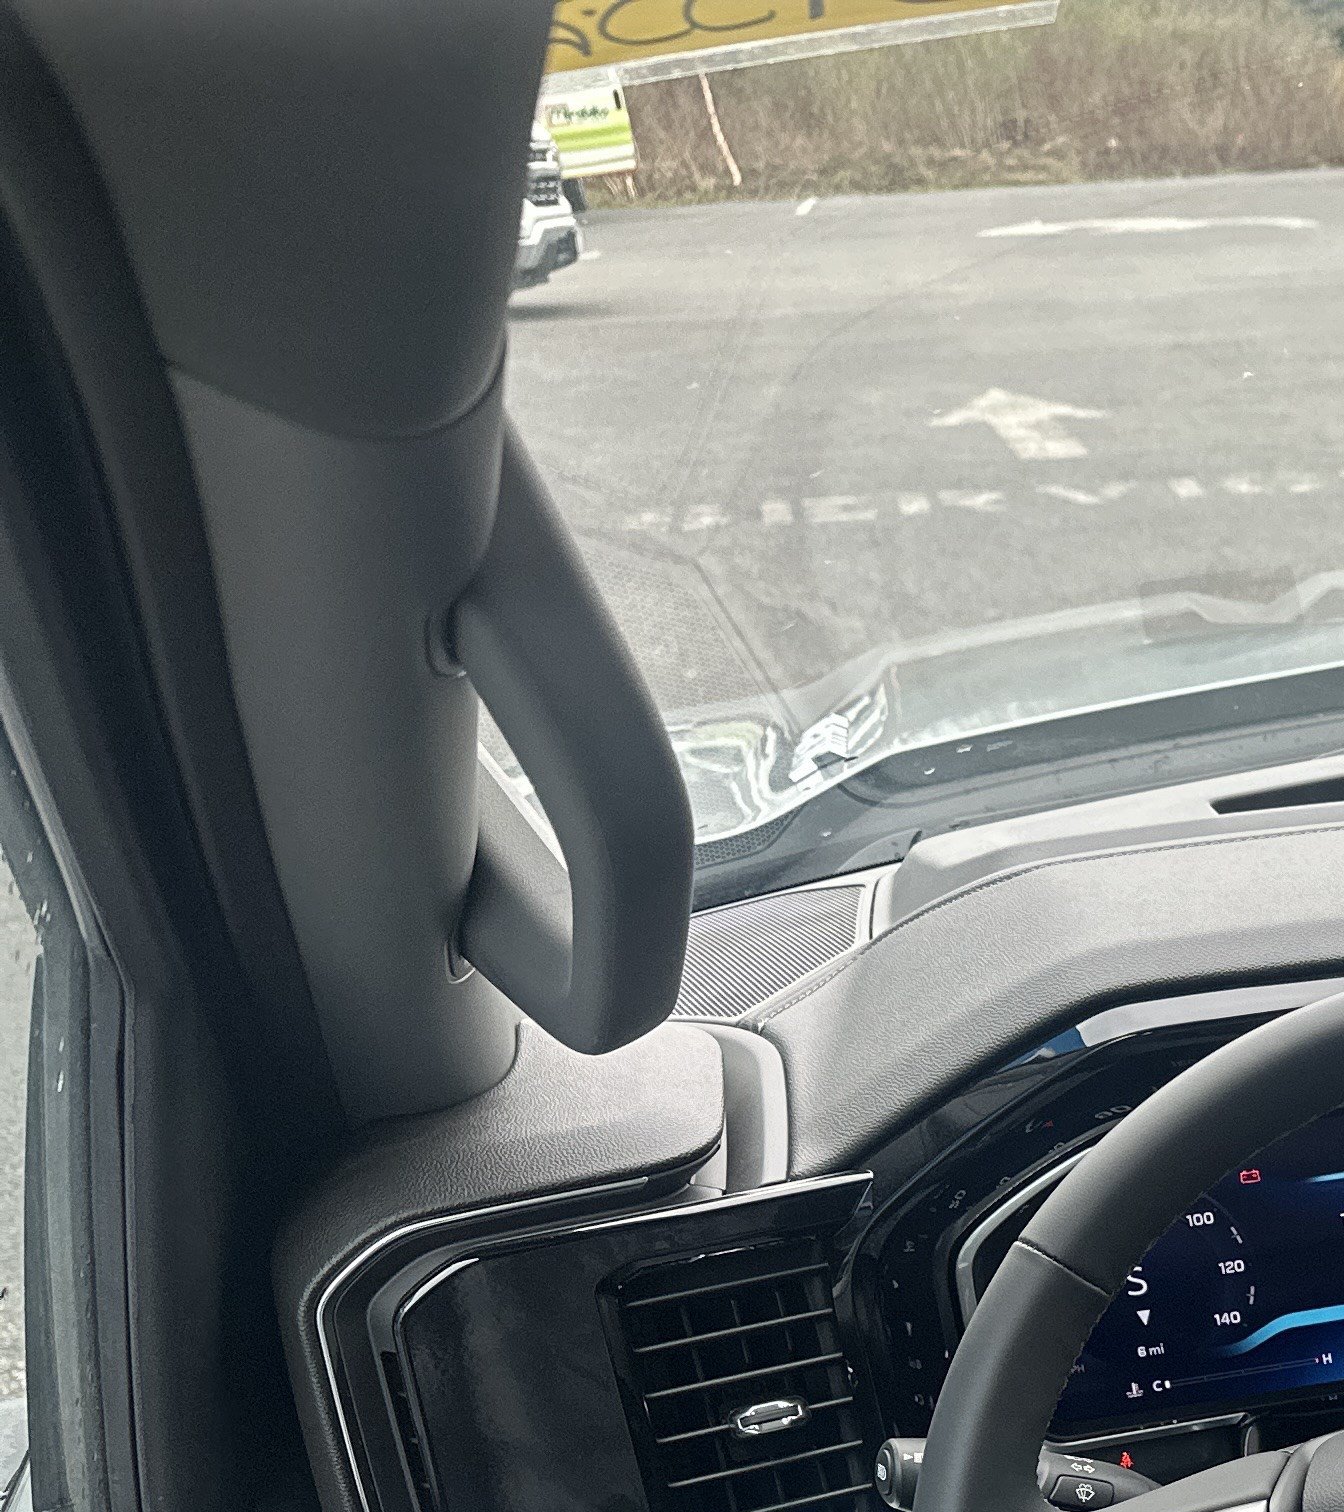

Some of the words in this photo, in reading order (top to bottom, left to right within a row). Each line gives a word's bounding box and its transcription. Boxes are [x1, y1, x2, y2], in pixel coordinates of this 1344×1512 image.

[1185, 1211, 1215, 1227] 100
[1218, 1259, 1245, 1275] 120
[1214, 1311, 1241, 1326] 140
[1149, 1342, 1165, 1356] mi
[1322, 1352, 1333, 1365] H
[1152, 1380, 1163, 1392] C
